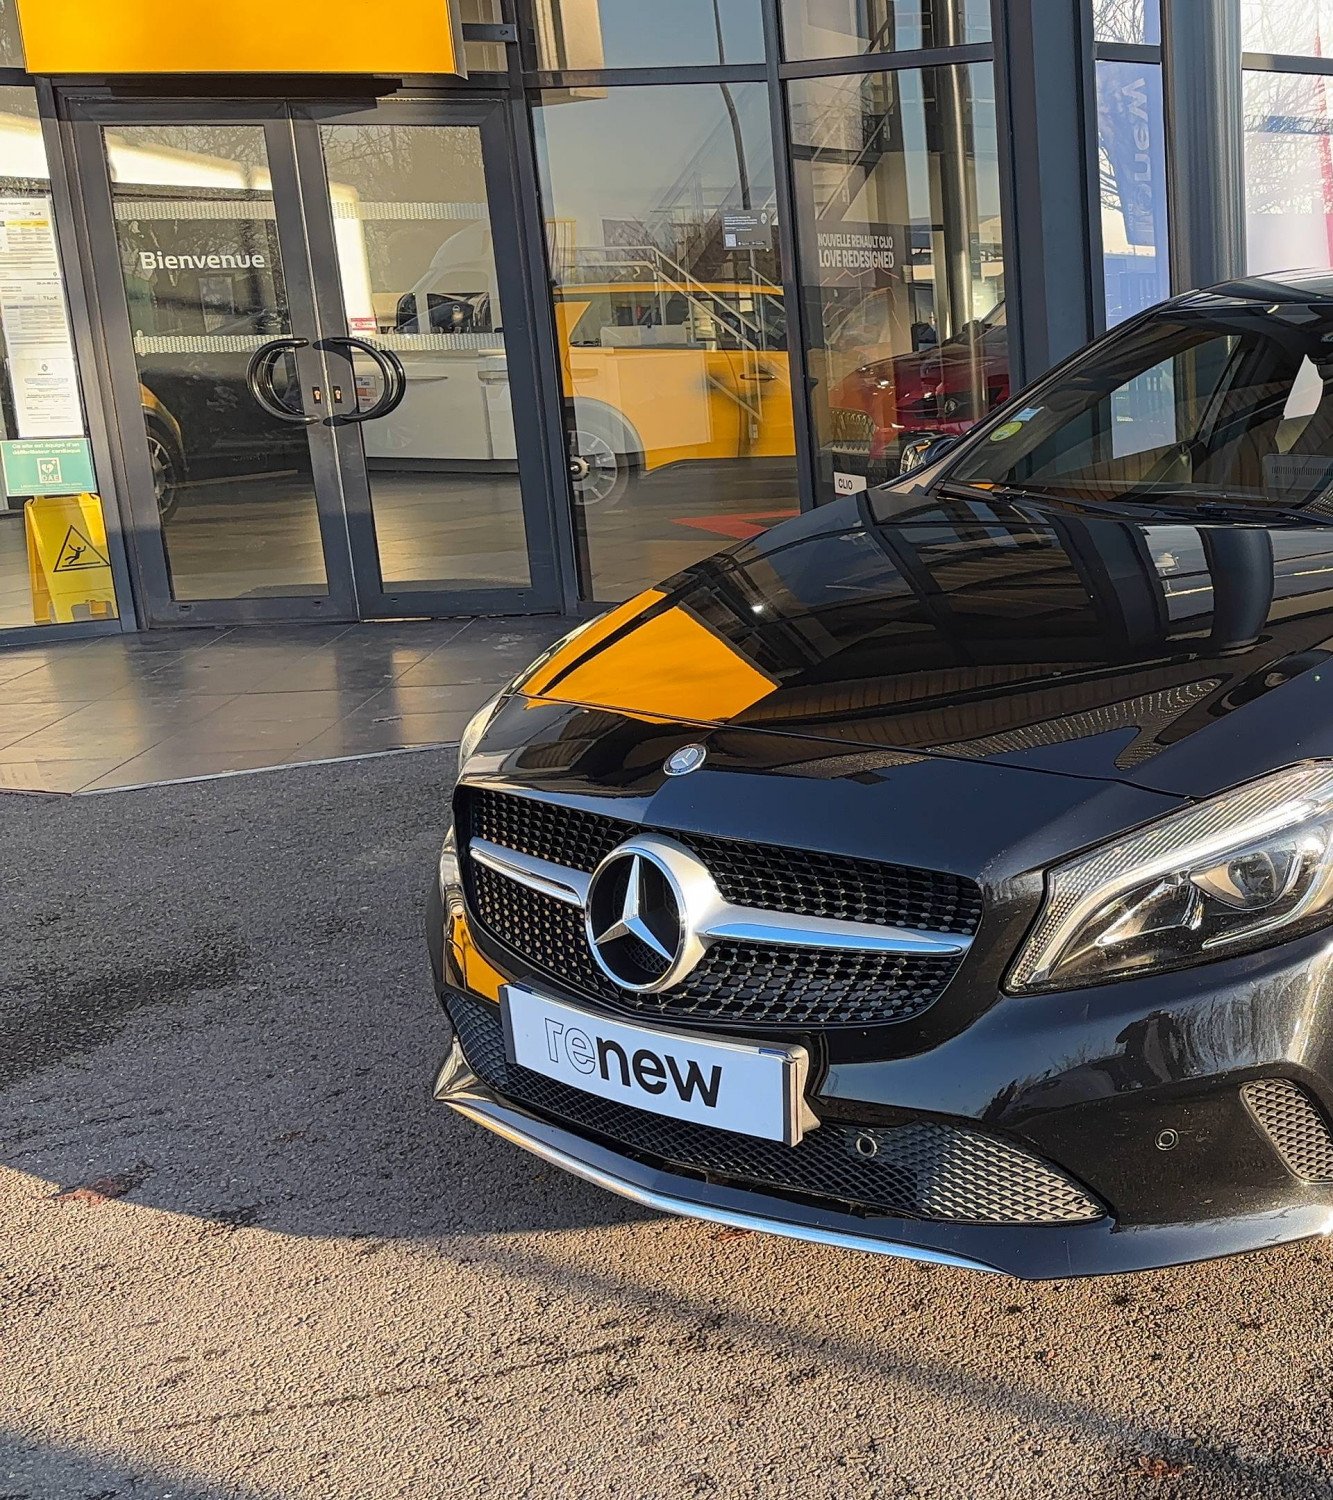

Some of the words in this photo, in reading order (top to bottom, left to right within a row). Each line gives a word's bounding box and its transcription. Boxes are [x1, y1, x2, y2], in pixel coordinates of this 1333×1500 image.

[817, 233, 851, 247] NOUVELLE
[851, 234, 879, 249] RENAULT
[879, 236, 893, 249] CLIO
[139, 251, 265, 269] Bienvenue
[819, 249, 842, 268] LOVE
[842, 250, 895, 268] REDESIGNED
[838, 478, 853, 490] CLIO
[544, 1017, 723, 1108] renew
